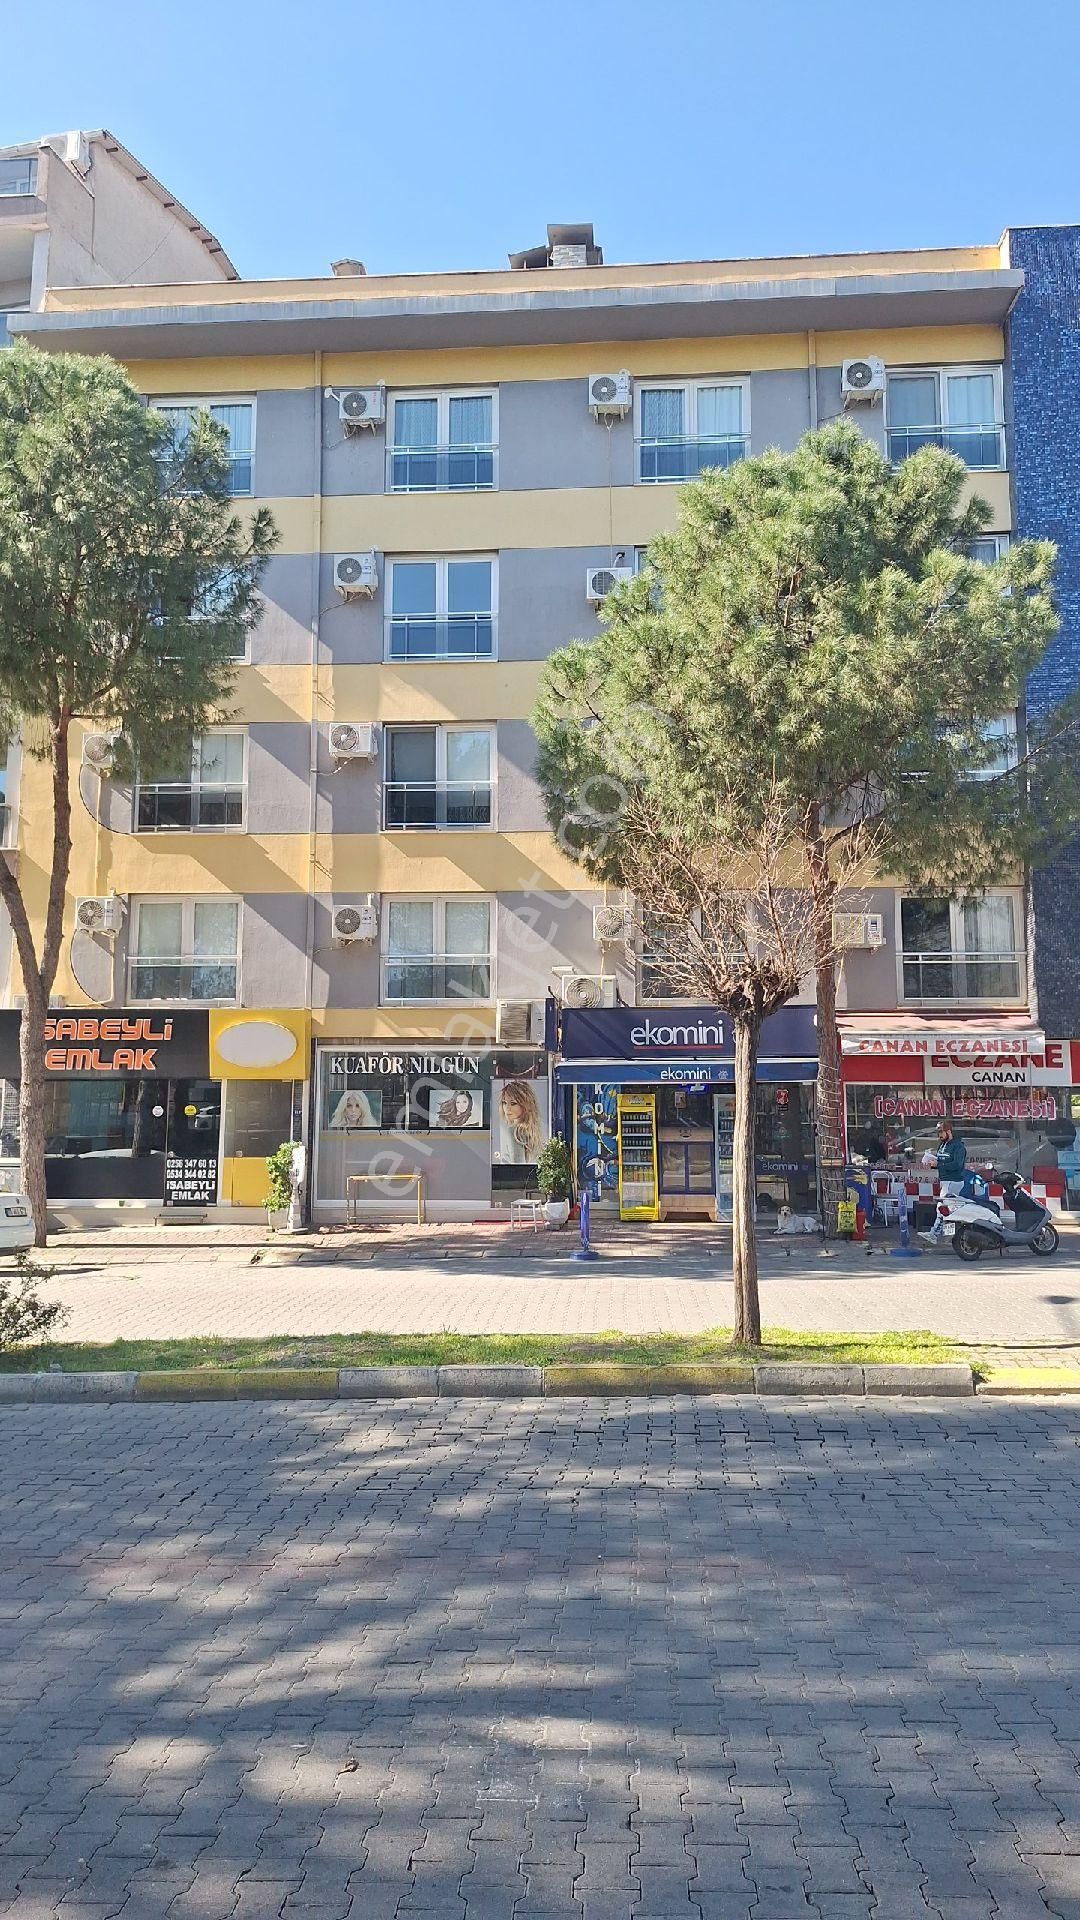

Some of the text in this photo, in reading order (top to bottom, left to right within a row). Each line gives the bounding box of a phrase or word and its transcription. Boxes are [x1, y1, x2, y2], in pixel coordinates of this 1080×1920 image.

[630, 1018, 724, 1046] ekomini
[859, 1039, 928, 1053] CANAN
[44, 1049, 158, 1070] EMLAK
[330, 1051, 480, 1074] KUAFÖR NİLGÜN
[660, 1066, 712, 1080] ekomini
[971, 1071, 1026, 1083] CANAN
[762, 1161, 799, 1171] ekomini
[171, 1191, 210, 1201] EMLAK
